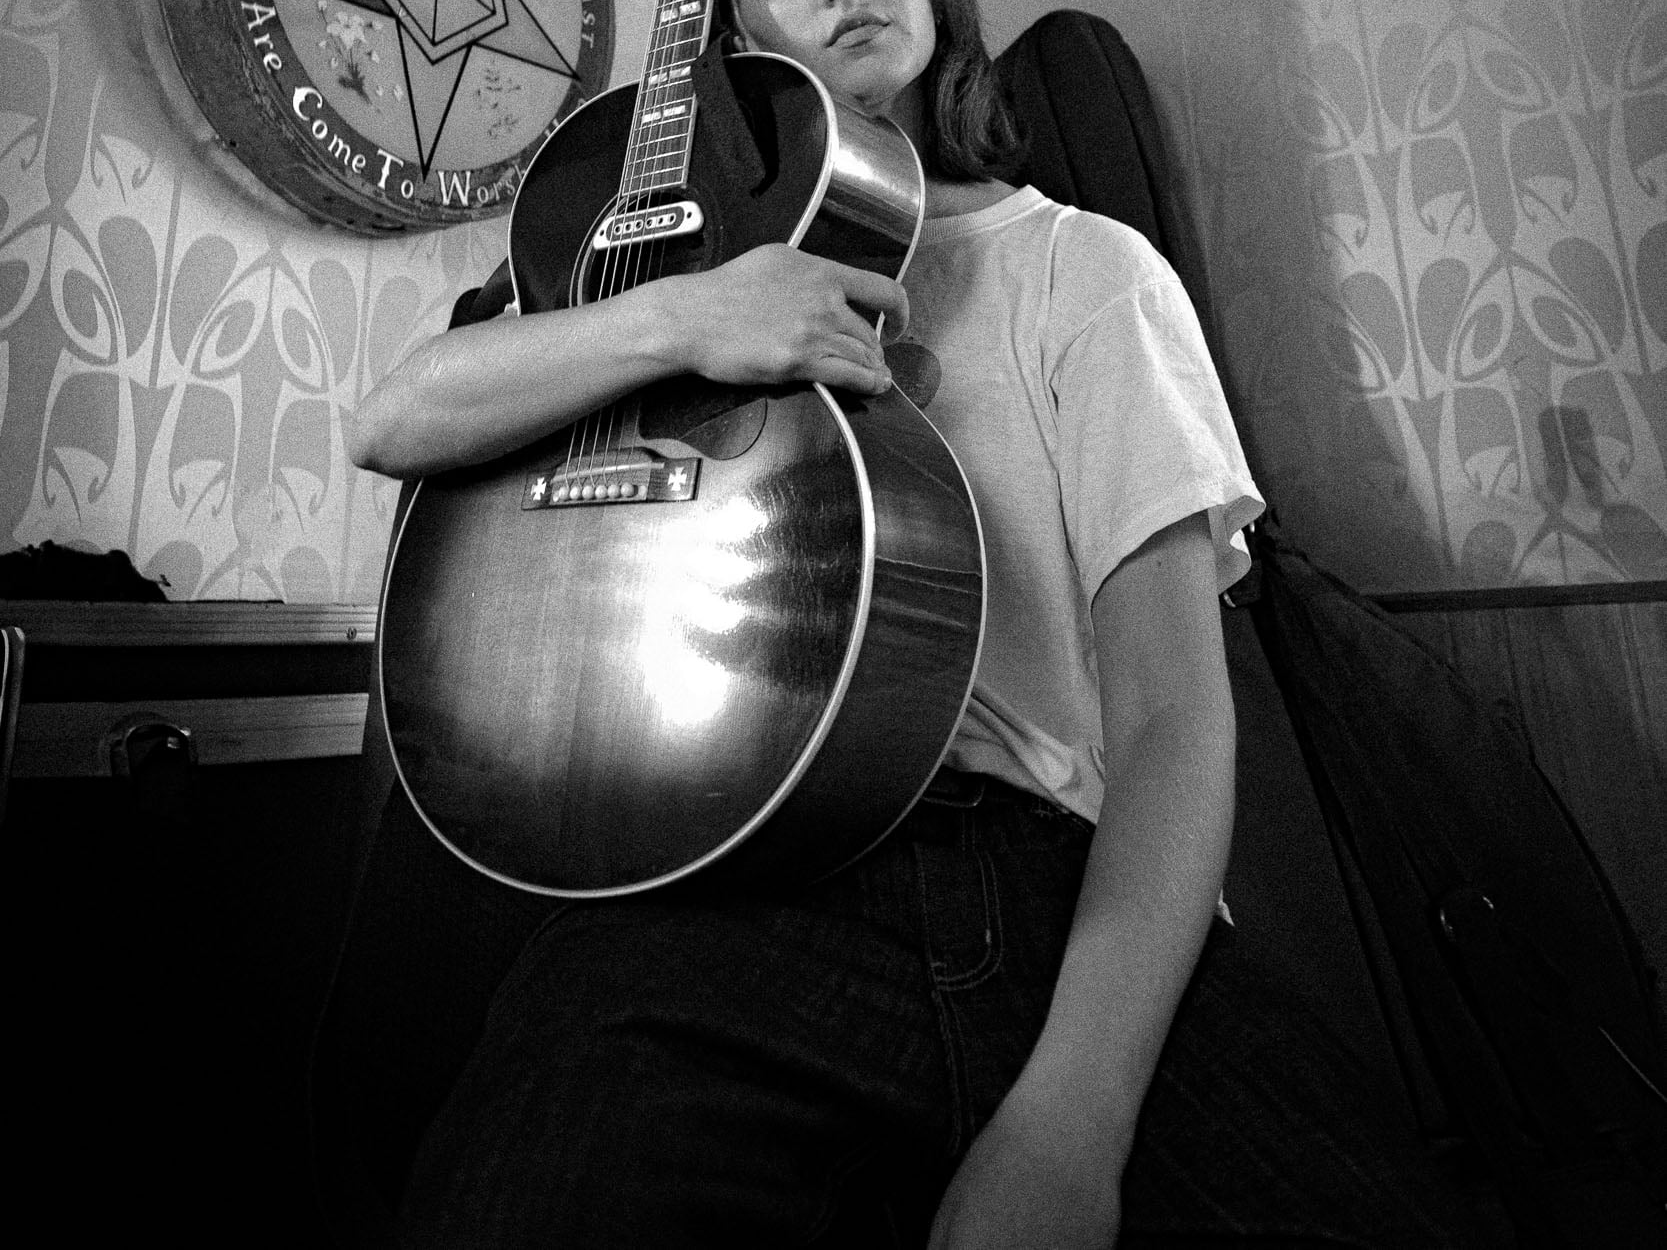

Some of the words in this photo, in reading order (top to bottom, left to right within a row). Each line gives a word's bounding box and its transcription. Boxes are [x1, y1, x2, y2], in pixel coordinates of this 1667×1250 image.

[241, 1, 283, 74] Are
[293, 86, 367, 174] Come
[376, 148, 415, 199] To
